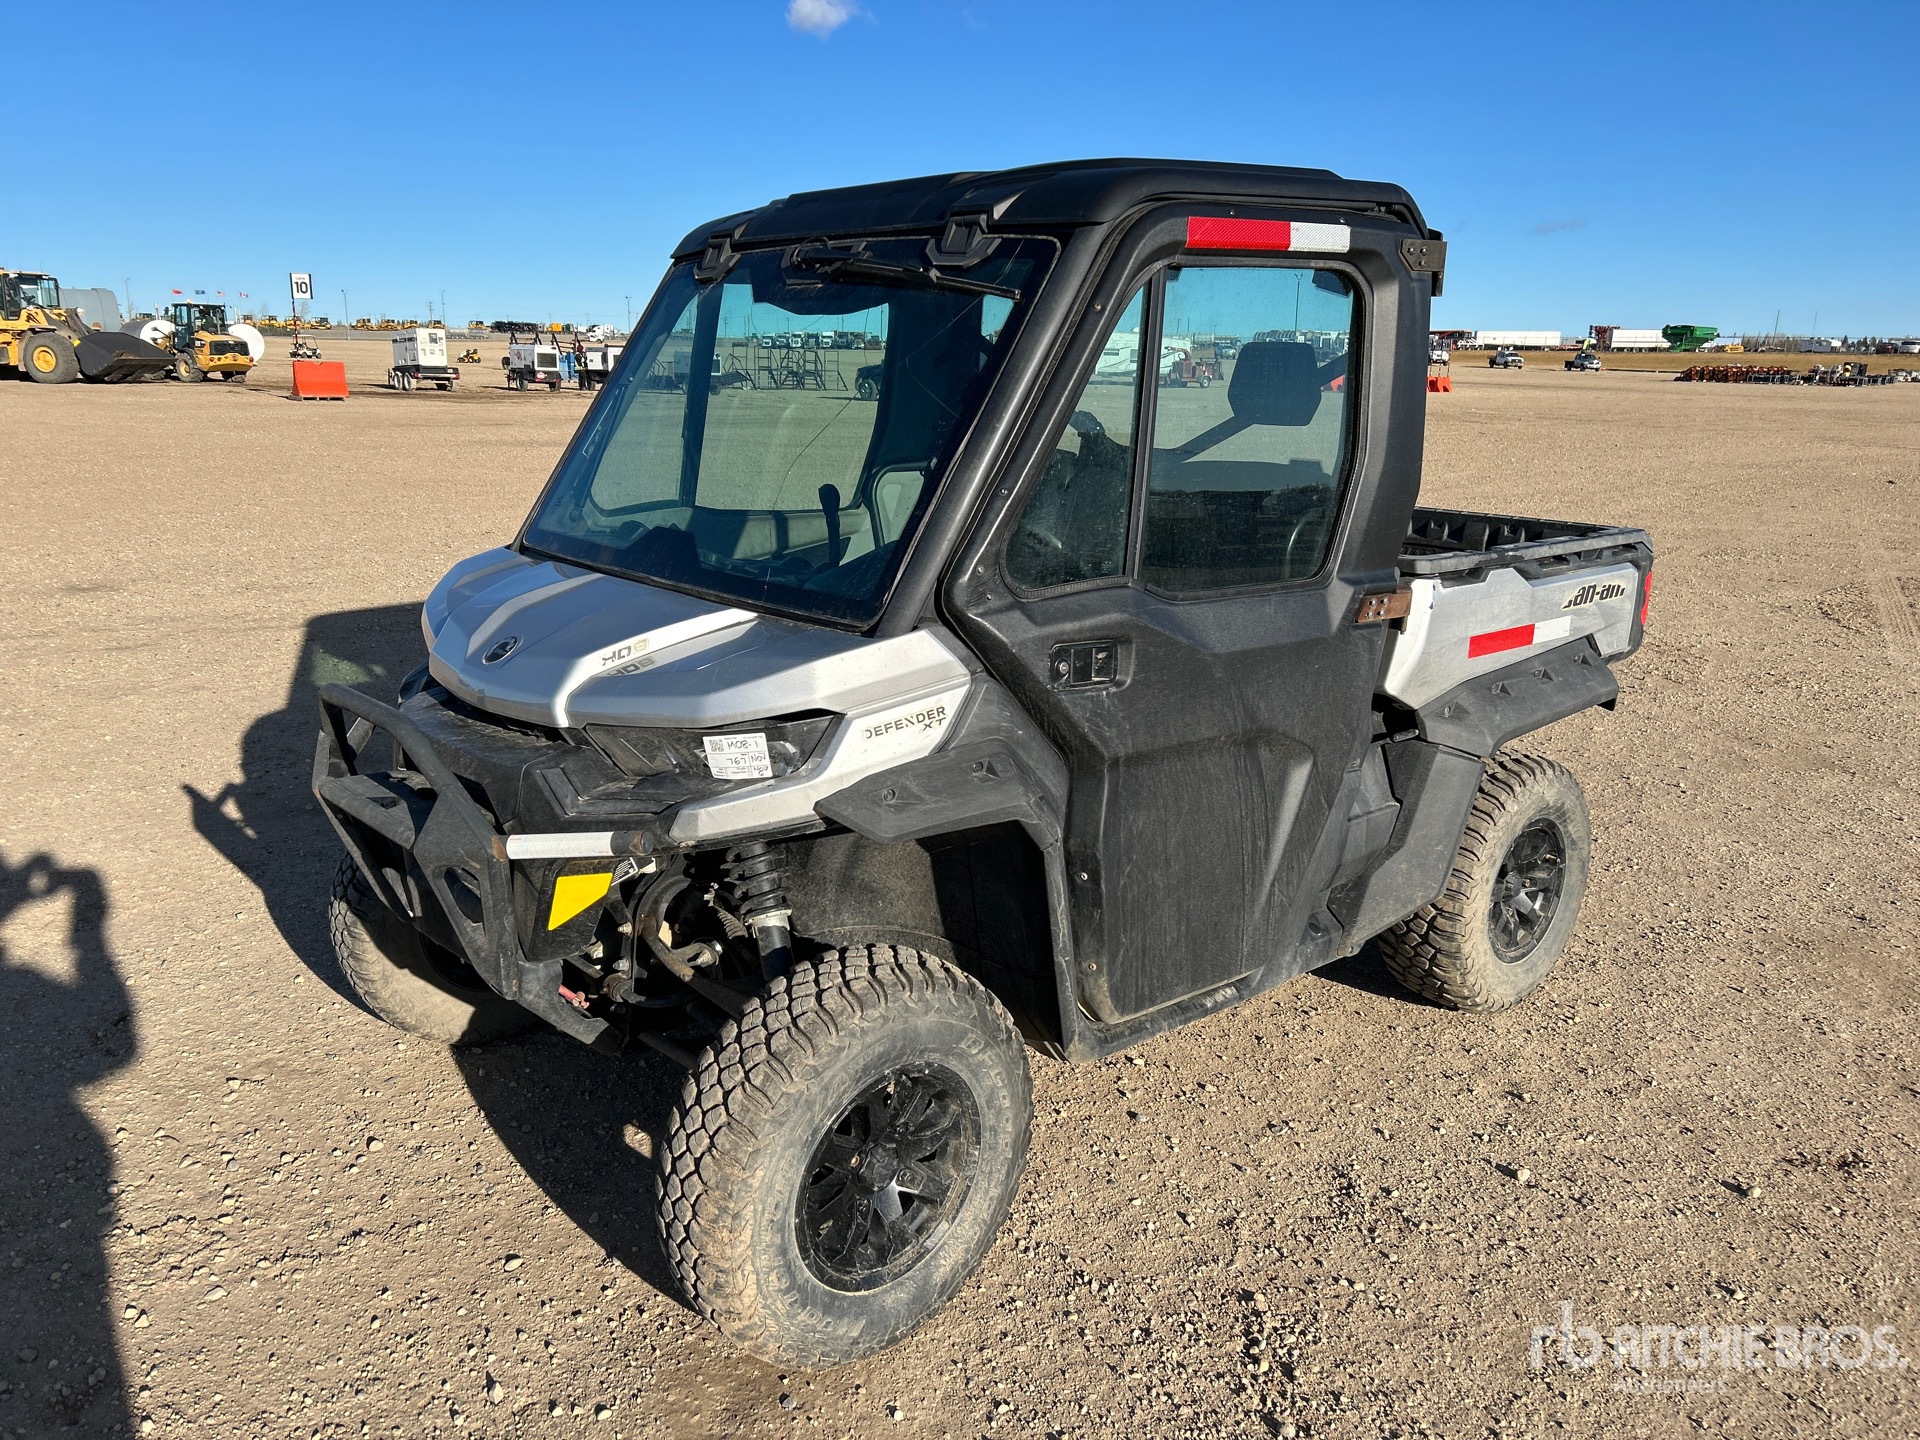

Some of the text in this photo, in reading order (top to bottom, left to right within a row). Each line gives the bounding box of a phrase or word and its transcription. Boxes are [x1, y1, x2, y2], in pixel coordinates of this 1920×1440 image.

[294, 281, 308, 294] 10
[864, 706, 947, 739] DEFENDER
[922, 717, 947, 731] XT
